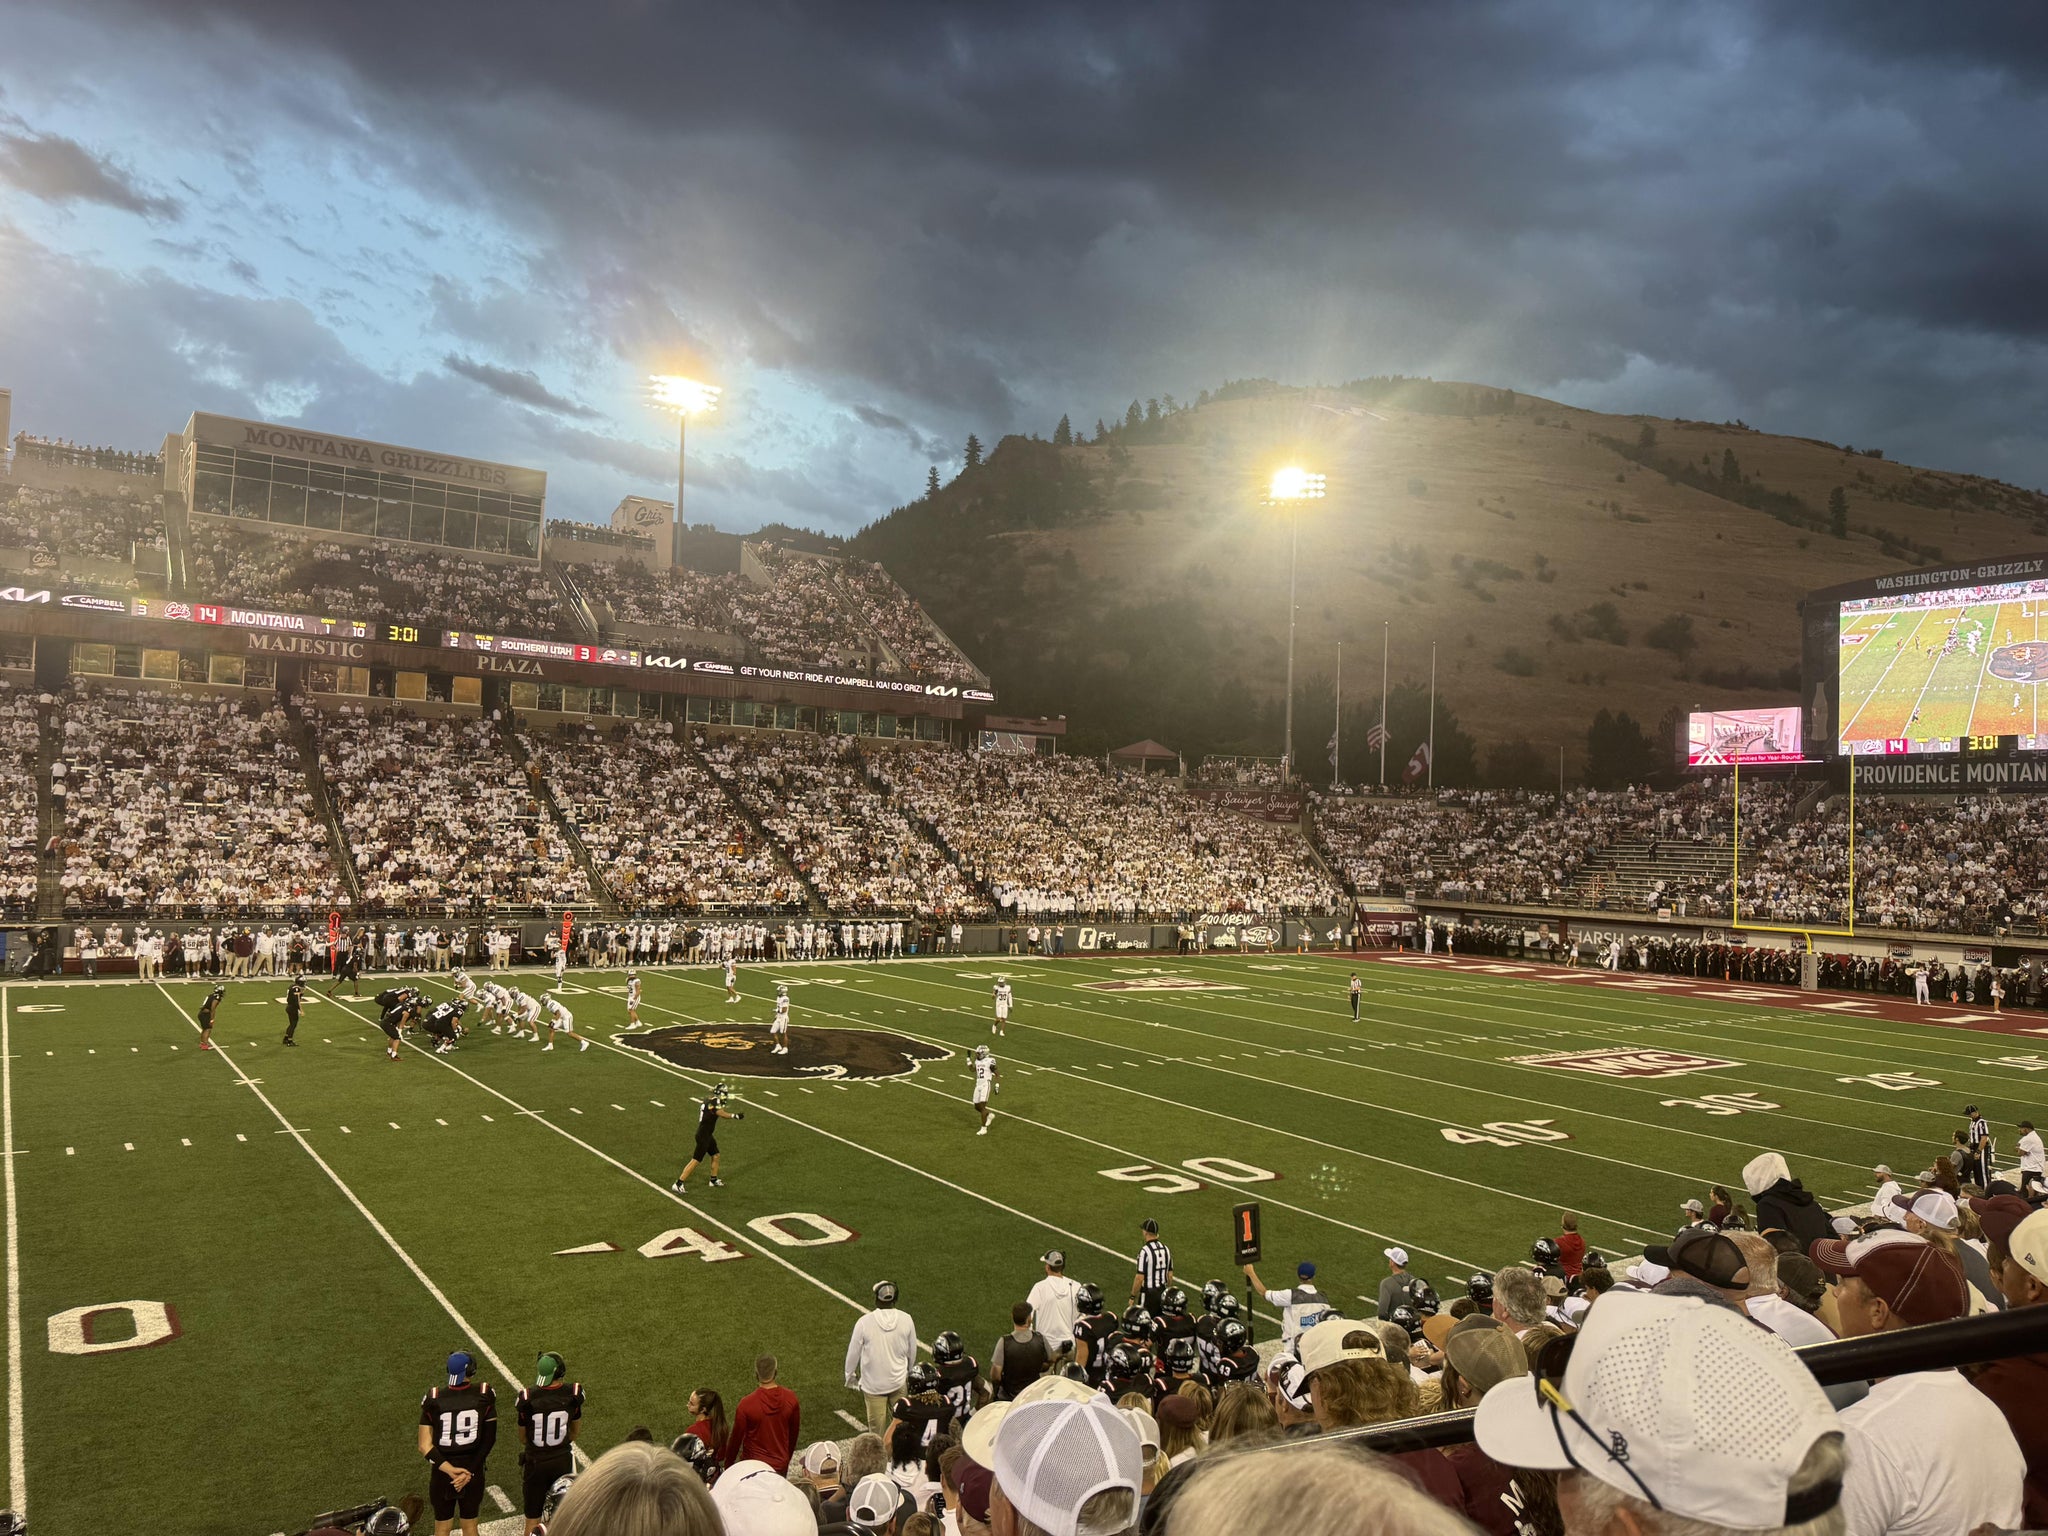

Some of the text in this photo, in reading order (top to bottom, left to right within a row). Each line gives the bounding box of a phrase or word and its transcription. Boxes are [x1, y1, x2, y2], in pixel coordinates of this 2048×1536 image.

[244, 427, 507, 486] MONTANA GRIZZLIES
[1875, 559, 2044, 590] WASHINGTON-GRIZZLY
[79, 597, 125, 609] CAMPBELL
[138, 605, 147, 615] 3
[200, 606, 217, 622] 14
[231, 610, 305, 630] MONTANA
[325, 623, 331, 635] 1
[352, 626, 366, 638] 10
[388, 625, 418, 642] 3:01
[248, 632, 364, 659] MAJESTIC
[450, 637, 459, 647] 2
[476, 640, 491, 650] 42
[501, 640, 572, 656] SOUTHERN UTAH
[580, 647, 590, 660] 3
[477, 655, 544, 676] PLAZA
[740, 666, 756, 677] GET
[759, 668, 781, 679] YOUR
[783, 670, 803, 681] NEXT
[805, 673, 823, 683] RIDE
[824, 675, 834, 684] AT
[835, 676, 875, 689] CAMPBELL
[876, 681, 890, 690] KIA!
[891, 683, 903, 692] GO
[904, 684, 923, 693] GRIZ!
[1889, 739, 1904, 752] 14
[1939, 742, 1951, 752] 10
[1968, 735, 1999, 751] 3:01
[2027, 739, 2035, 749] 2
[1854, 763, 1960, 784] PROVIDENCE
[1220, 791, 1265, 809] Sawyer
[1267, 794, 1301, 814] Sawyer
[1440, 1121, 1575, 1147] 40
[1099, 1157, 1283, 1194] 50
[1241, 1210, 1253, 1242] 1
[637, 1212, 861, 1262] 40
[1218, 1364, 1231, 1377] 43
[439, 1409, 479, 1447] 19
[531, 1410, 569, 1448] 10
[920, 1419, 938, 1447] 4
